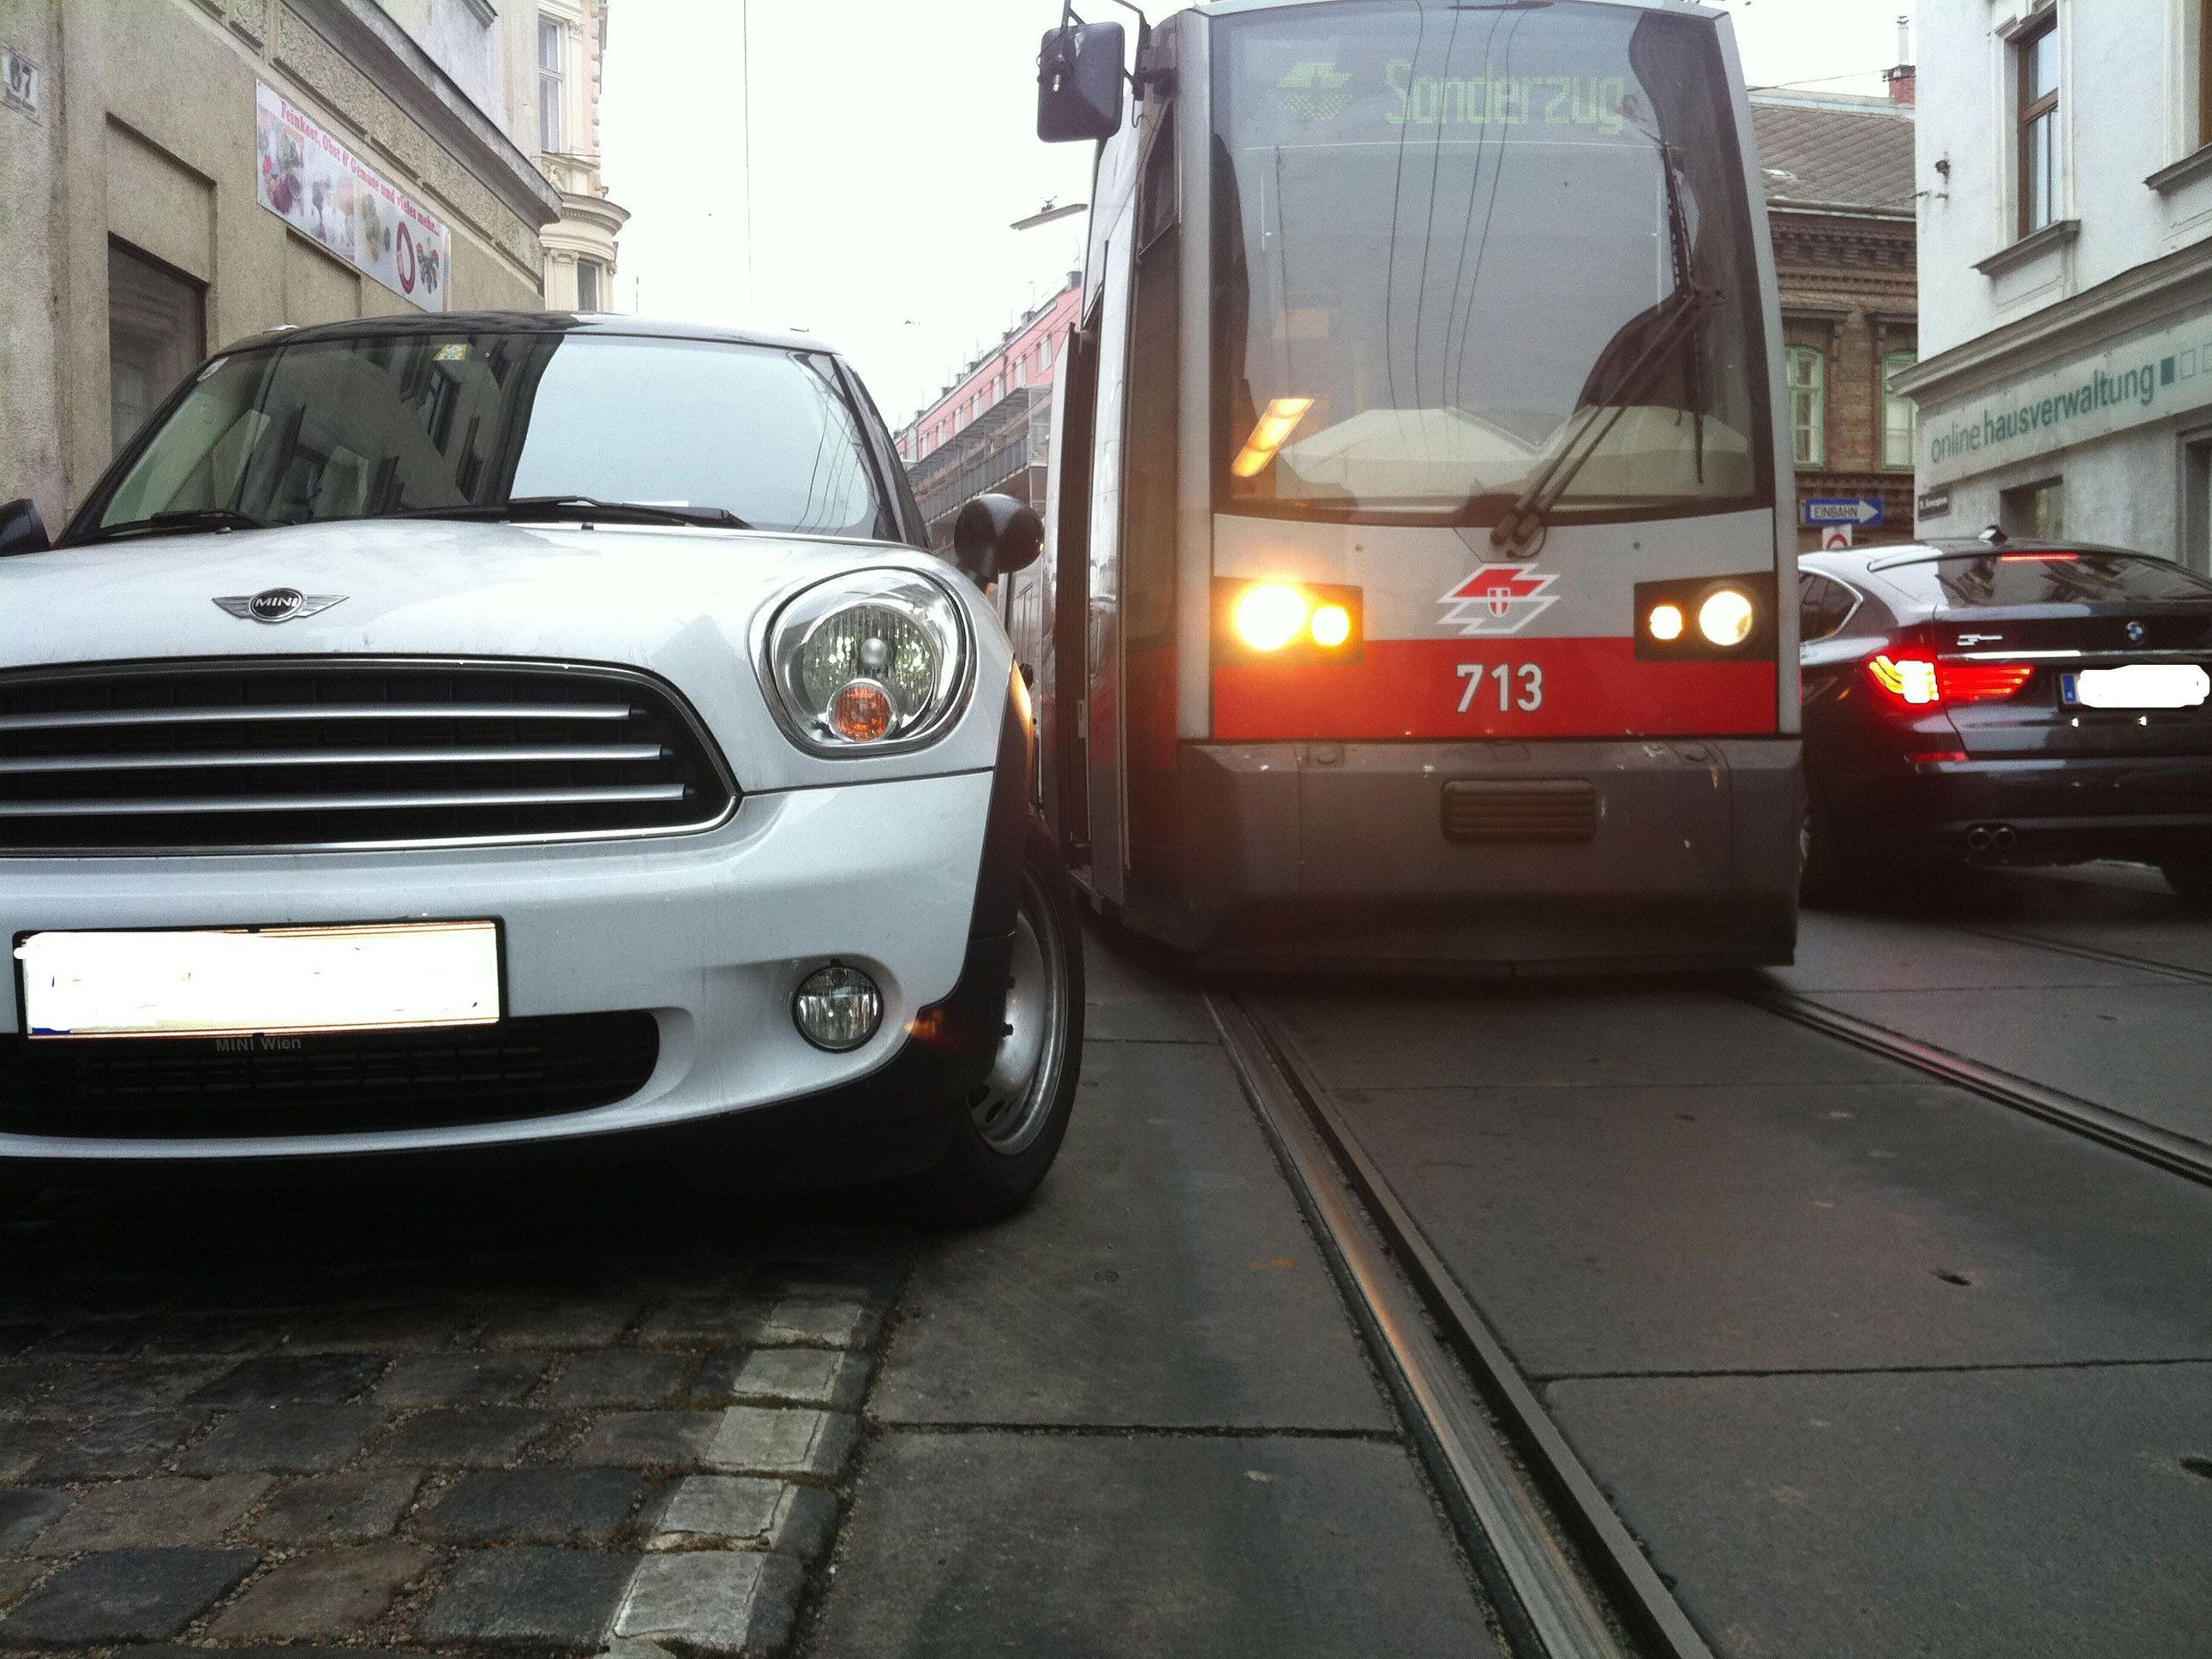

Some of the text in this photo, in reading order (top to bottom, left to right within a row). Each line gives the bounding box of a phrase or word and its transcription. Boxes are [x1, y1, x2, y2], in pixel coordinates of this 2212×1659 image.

[1385, 60, 1624, 134] Sonderzug
[381, 183, 395, 204] und
[1813, 506, 1858, 518] EINBAHN
[255, 596, 299, 608] MINI
[1456, 662, 1544, 713] 713
[215, 1036, 302, 1052] MINI Wien
